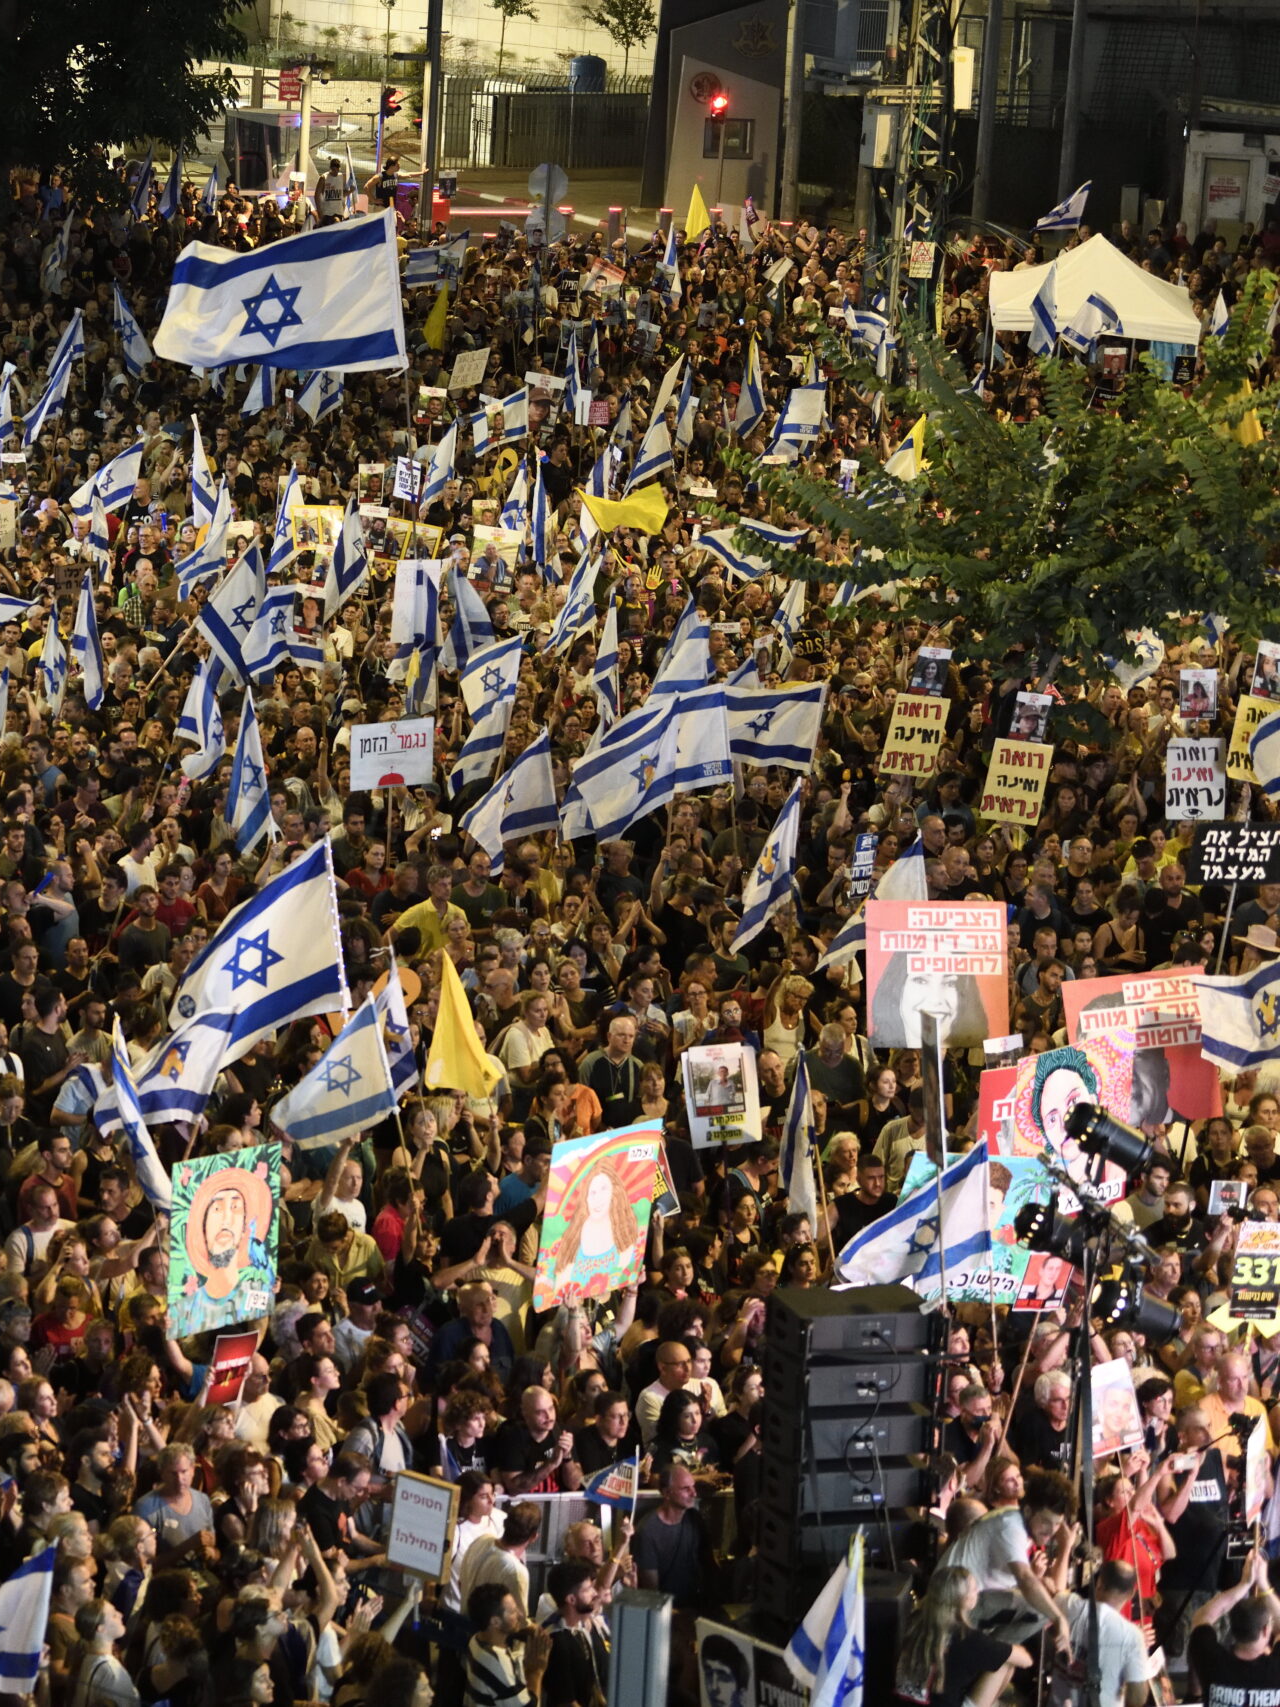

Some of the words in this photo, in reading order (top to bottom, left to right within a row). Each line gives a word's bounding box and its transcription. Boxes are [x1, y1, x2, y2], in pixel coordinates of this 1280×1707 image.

[897, 701, 942, 720] רואה
[397, 733, 426, 749] נגמר
[894, 726, 940, 744] ואינה
[360, 736, 388, 759] הזמן
[1173, 747, 1219, 762] רואה
[882, 751, 936, 773] נראית
[999, 748, 1044, 769] רואה
[997, 774, 1039, 793] ואינה
[1171, 767, 1214, 782] ואינה
[980, 794, 1038, 819] נראית
[1166, 787, 1225, 807] נראית
[1201, 830, 1231, 846] את
[1203, 846, 1271, 862] המדינה
[1200, 864, 1266, 881] מעצמך
[912, 911, 997, 927] הצביעה:
[883, 933, 927, 949] מוות
[933, 934, 960, 952] דין
[966, 934, 998, 950] גזר
[911, 955, 998, 973] לחטופים
[1125, 979, 1197, 1001] הצביע:
[1083, 1009, 1128, 1030] מוות
[1134, 1006, 1160, 1027] דין
[1166, 1002, 1201, 1019] גזר
[1136, 1023, 1202, 1048] לחטופ
[401, 1490, 442, 1512] חטופים
[395, 1528, 437, 1553] תחילה!
[1209, 1684, 1245, 1705] BRING
